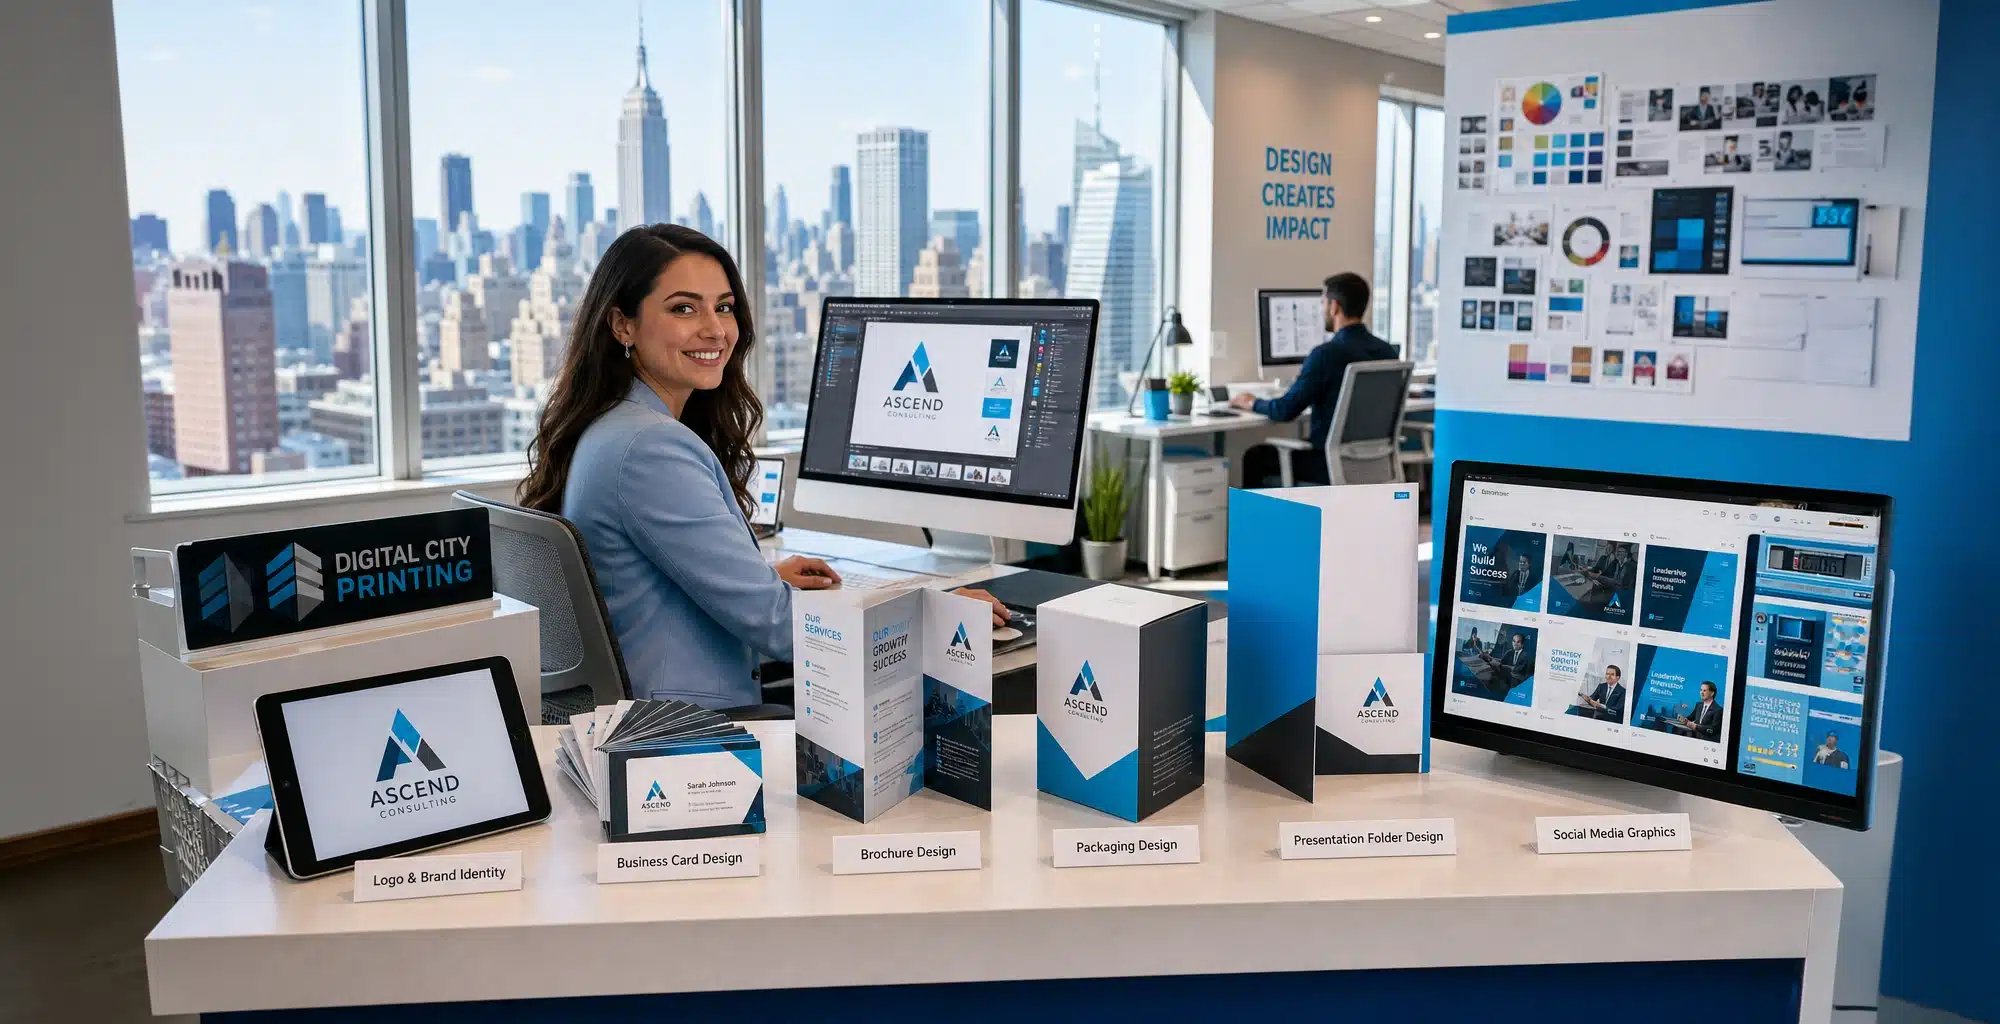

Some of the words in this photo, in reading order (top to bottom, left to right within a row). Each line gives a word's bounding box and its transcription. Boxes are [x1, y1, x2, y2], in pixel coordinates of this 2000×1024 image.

[1265, 146, 1332, 176] DESIGN
[1262, 182, 1335, 209] CREATES
[1266, 215, 1331, 240] IMPACT
[883, 396, 944, 411] ASCEND
[886, 411, 937, 420] CONSULTING
[335, 544, 420, 574] DIGITAL
[426, 536, 471, 561] CITY
[1472, 543, 1487, 554] We
[1470, 565, 1507, 579] Success
[338, 559, 473, 603] PRINTING
[805, 613, 820, 624] OUR
[805, 624, 842, 641] SERVICES
[873, 627, 889, 642] OUR
[873, 634, 908, 657] GROWTH
[873, 649, 907, 672] SUCCESS
[946, 648, 976, 662] ASCEND
[1064, 697, 1108, 717] ASCEND
[1357, 709, 1399, 719] ASCEND
[370, 774, 460, 808] ASCEND
[687, 782, 707, 790] Sarah
[708, 780, 736, 788] Johnson
[379, 796, 457, 819] CONSULTING
[1294, 834, 1365, 847] Presentation
[1368, 832, 1403, 845] Folder
[1405, 831, 1444, 845] Design
[1553, 828, 1587, 840] Social
[1590, 827, 1624, 839] Media
[1627, 826, 1676, 841] Graphics
[861, 848, 914, 860] Brochure
[917, 846, 956, 859] Design
[1076, 841, 1135, 854] Packaging
[1138, 839, 1178, 853] Design
[617, 857, 668, 868] Business
[671, 854, 699, 866] Card
[702, 852, 743, 866] Design
[373, 872, 404, 888] Logo
[408, 873, 417, 884] &
[420, 869, 456, 883] Brand
[460, 867, 506, 882] Identity
